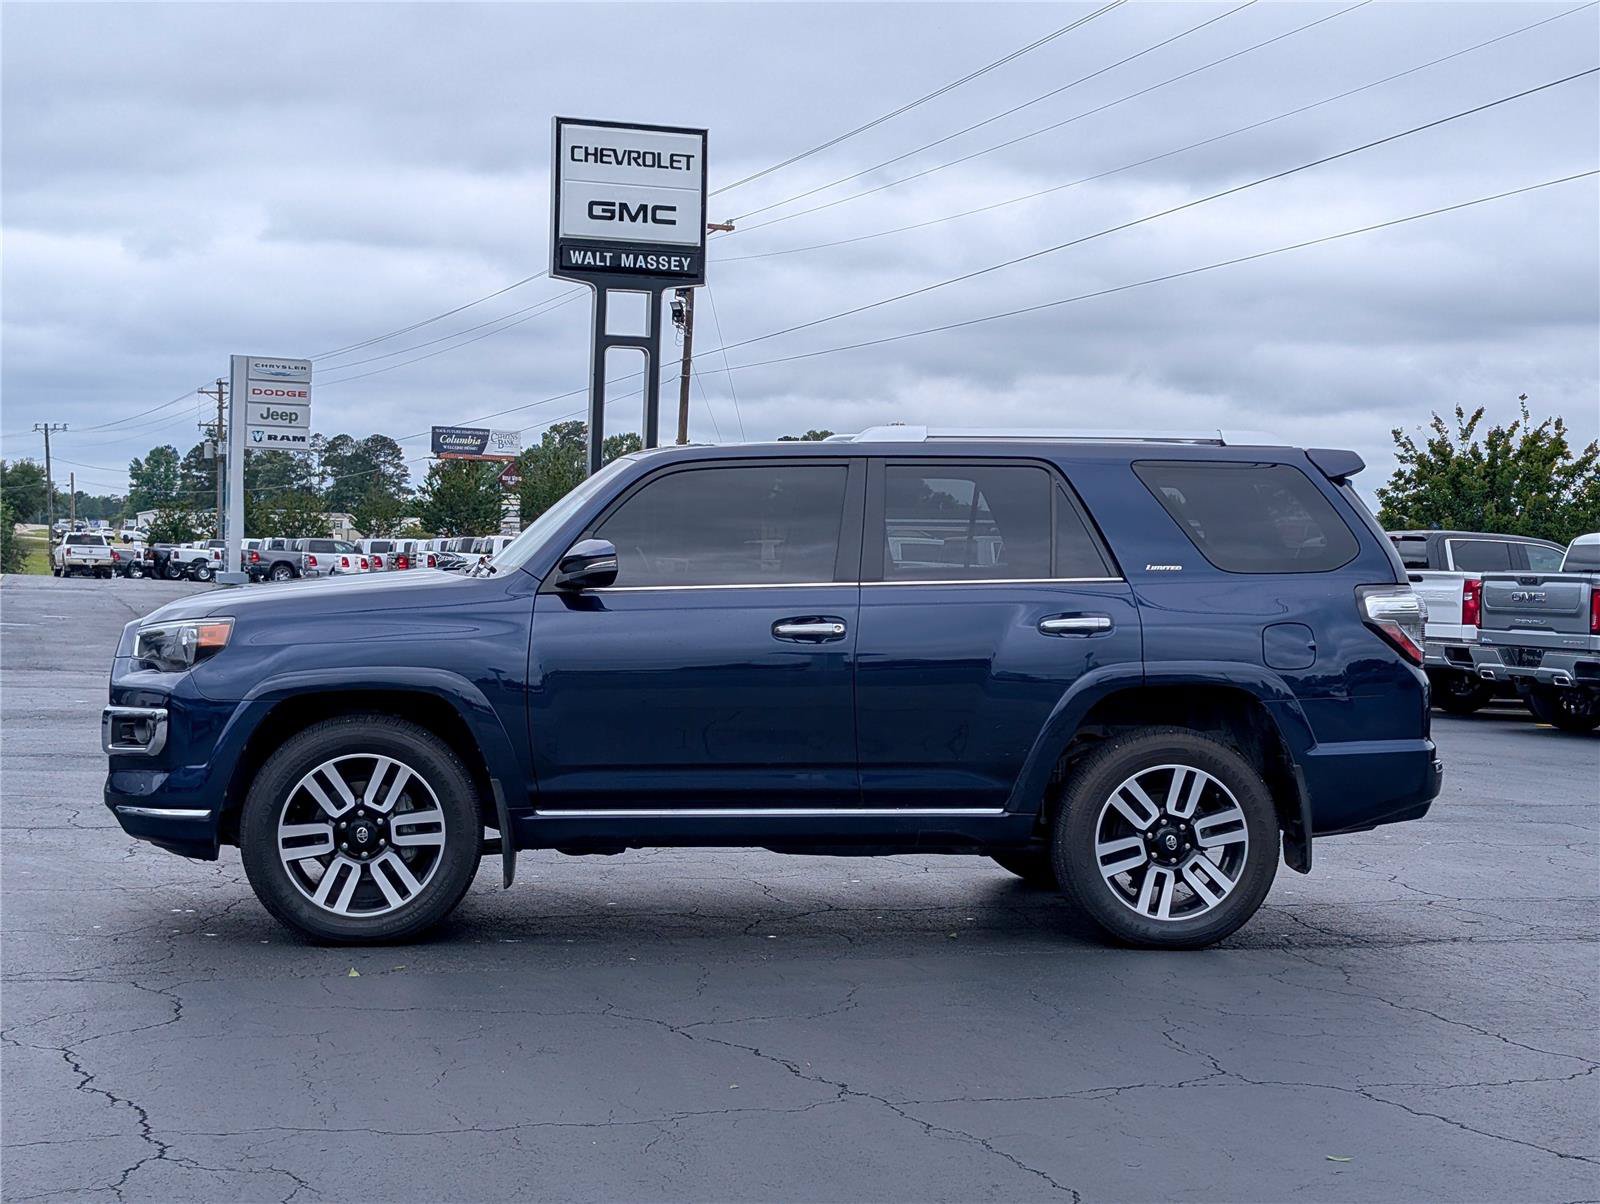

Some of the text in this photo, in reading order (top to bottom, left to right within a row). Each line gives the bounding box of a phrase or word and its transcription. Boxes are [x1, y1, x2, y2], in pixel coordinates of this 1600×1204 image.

[570, 145, 695, 171] CHEVROLET
[588, 200, 677, 225] GMC
[570, 250, 691, 271] WALT MASSEY
[254, 363, 307, 371] CHRYSLER
[252, 388, 307, 398] DODGE
[260, 407, 298, 424] Jeep
[267, 434, 306, 442] RAM
[440, 434, 481, 445] Columbia
[1511, 591, 1546, 603] GMC
